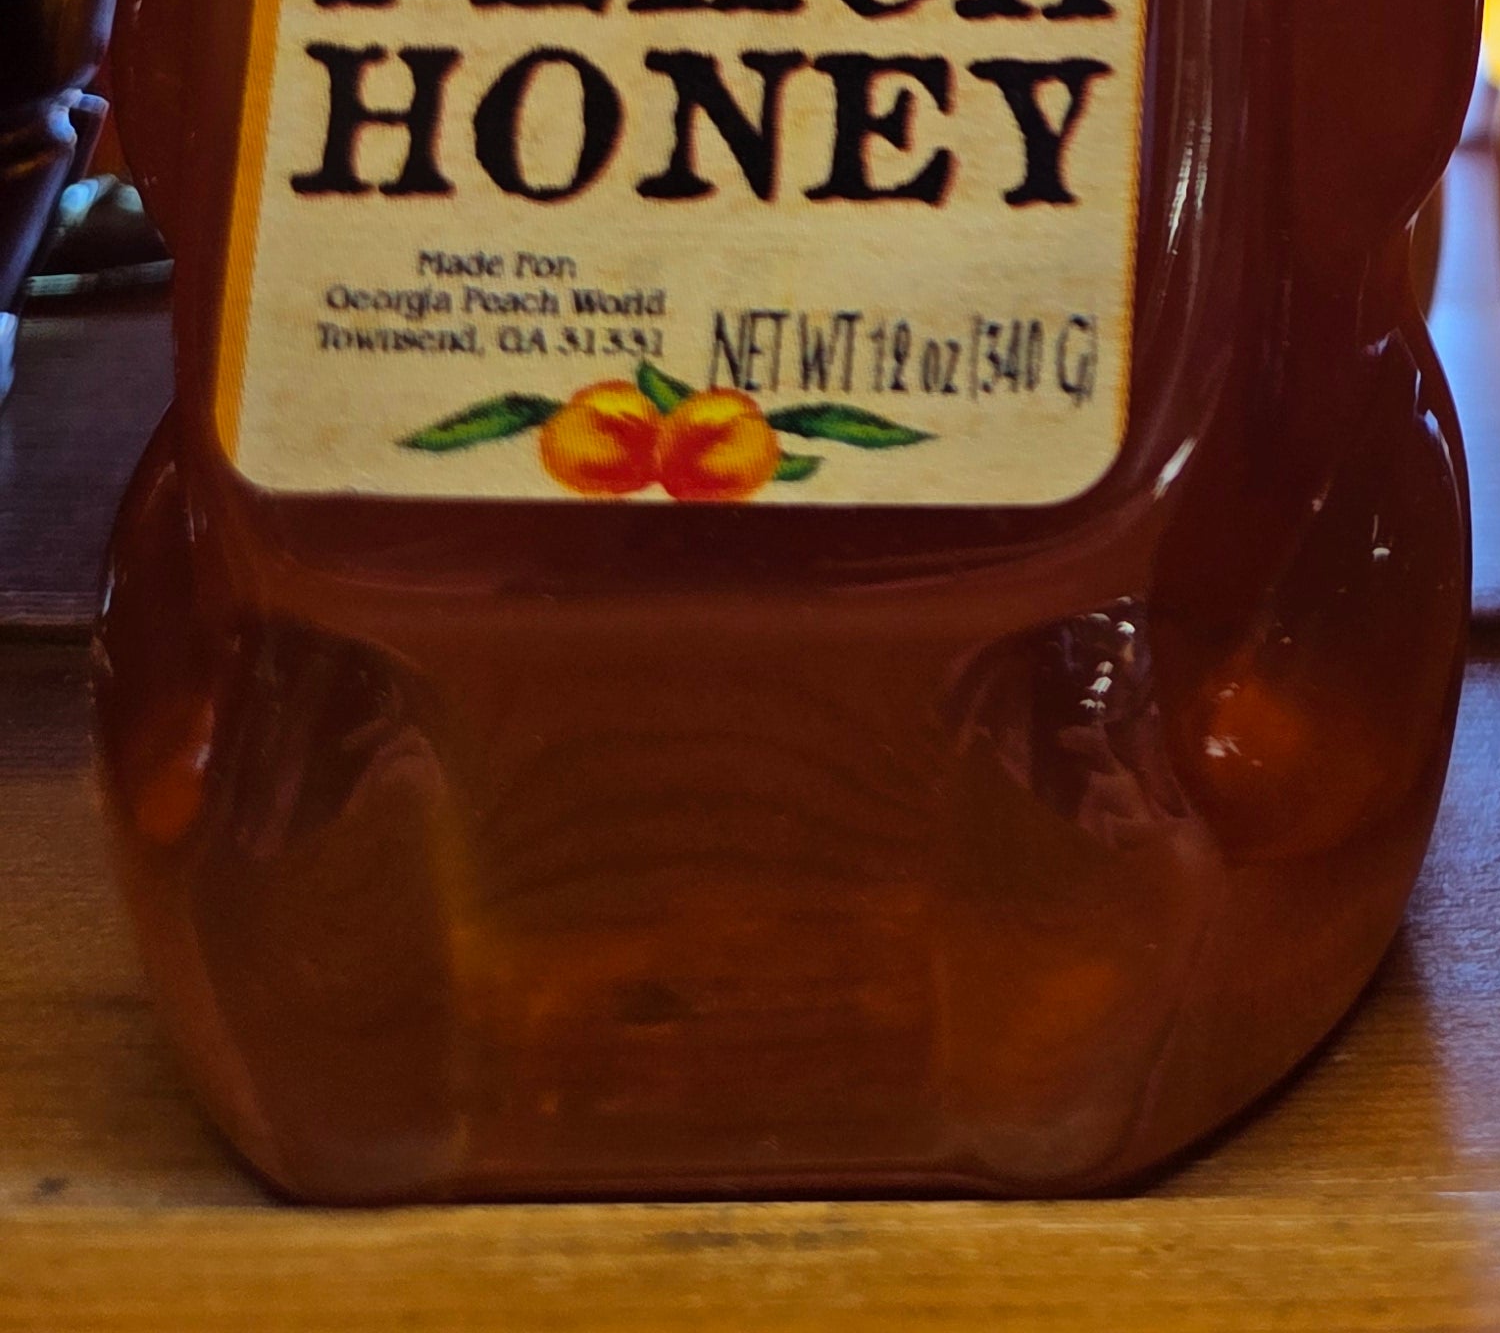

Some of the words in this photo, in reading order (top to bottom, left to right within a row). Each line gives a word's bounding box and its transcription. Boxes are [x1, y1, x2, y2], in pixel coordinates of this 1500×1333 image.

[289, 42, 1115, 208] HONEY
[417, 249, 504, 279] Made
[325, 283, 452, 322] Georgia
[462, 286, 560, 316] Peach
[572, 287, 667, 317] World
[316, 321, 485, 358] Townsend,
[498, 325, 548, 355] GA
[555, 327, 665, 358] 31331
[709, 310, 789, 393] NET
[800, 310, 861, 393] WT
[871, 318, 912, 393] 12
[921, 337, 960, 395] oz
[970, 311, 1044, 401] (340
